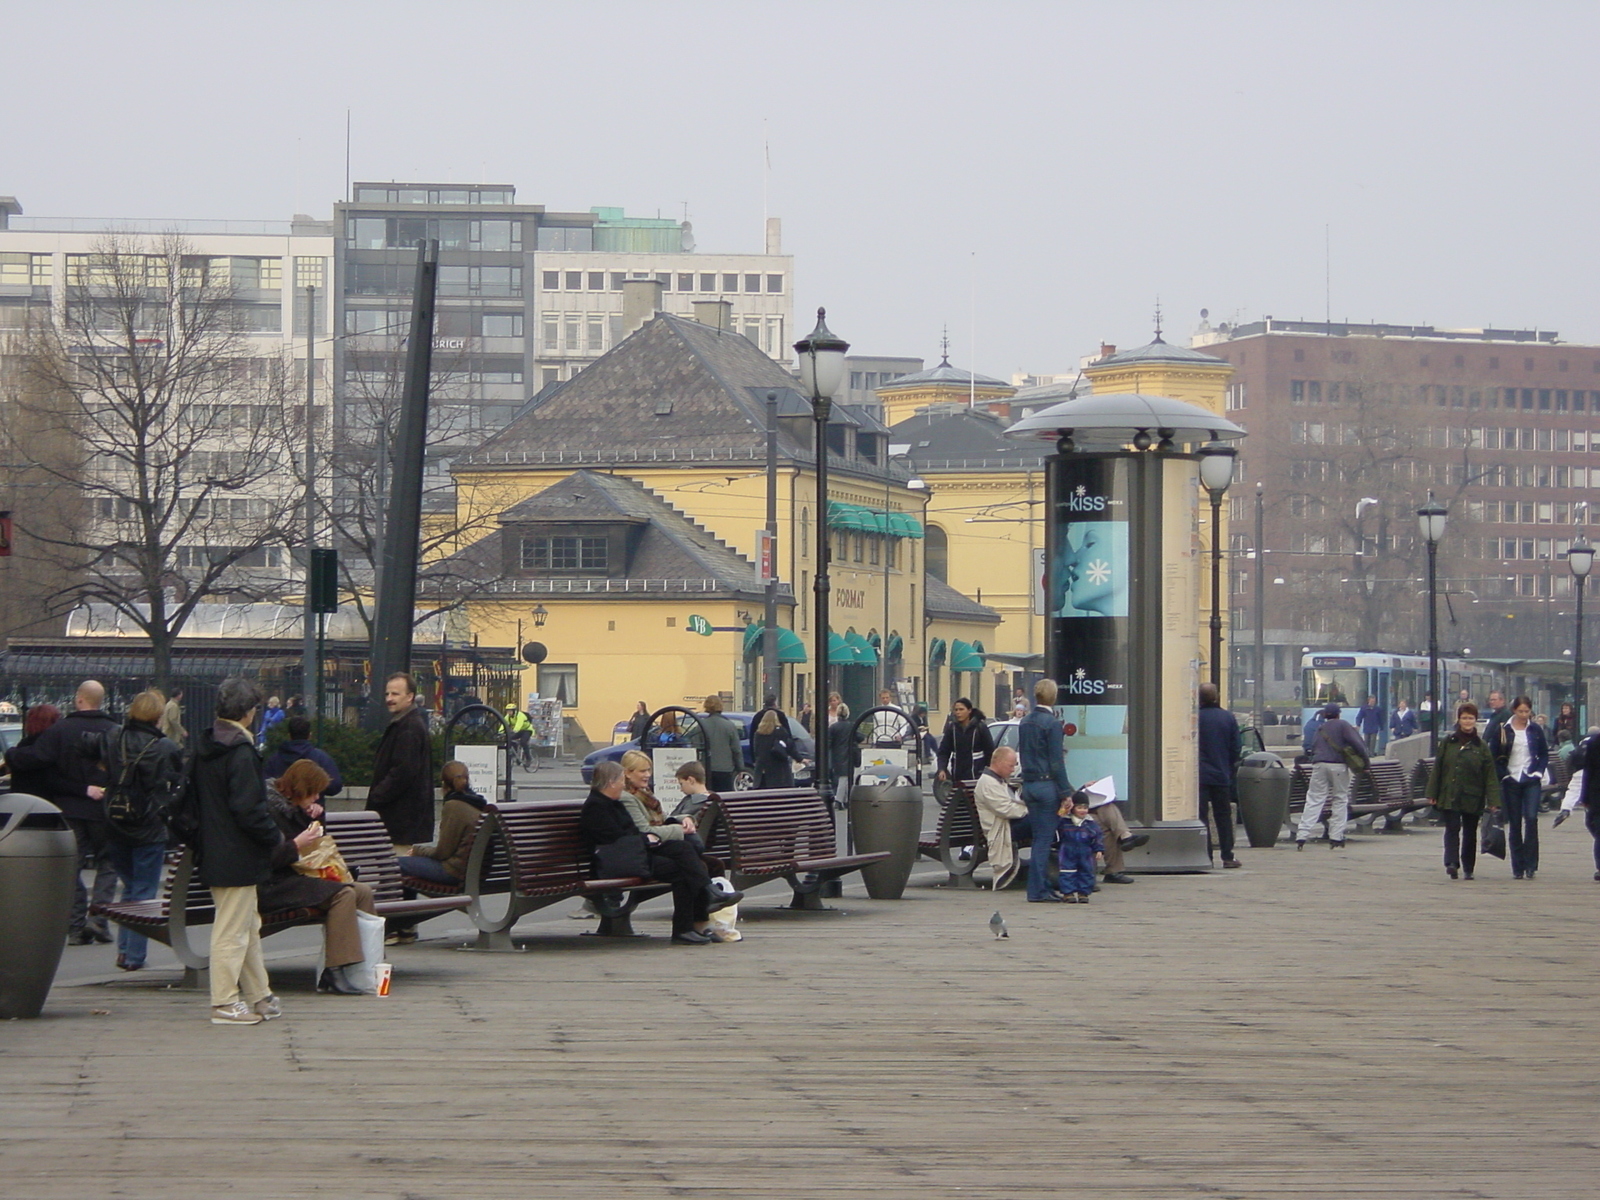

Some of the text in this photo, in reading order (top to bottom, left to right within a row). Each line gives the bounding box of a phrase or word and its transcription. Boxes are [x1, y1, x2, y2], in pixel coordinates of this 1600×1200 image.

[1070, 485, 1105, 511] kiss
[836, 588, 865, 609] FORMAT
[1069, 668, 1105, 694] kiss
